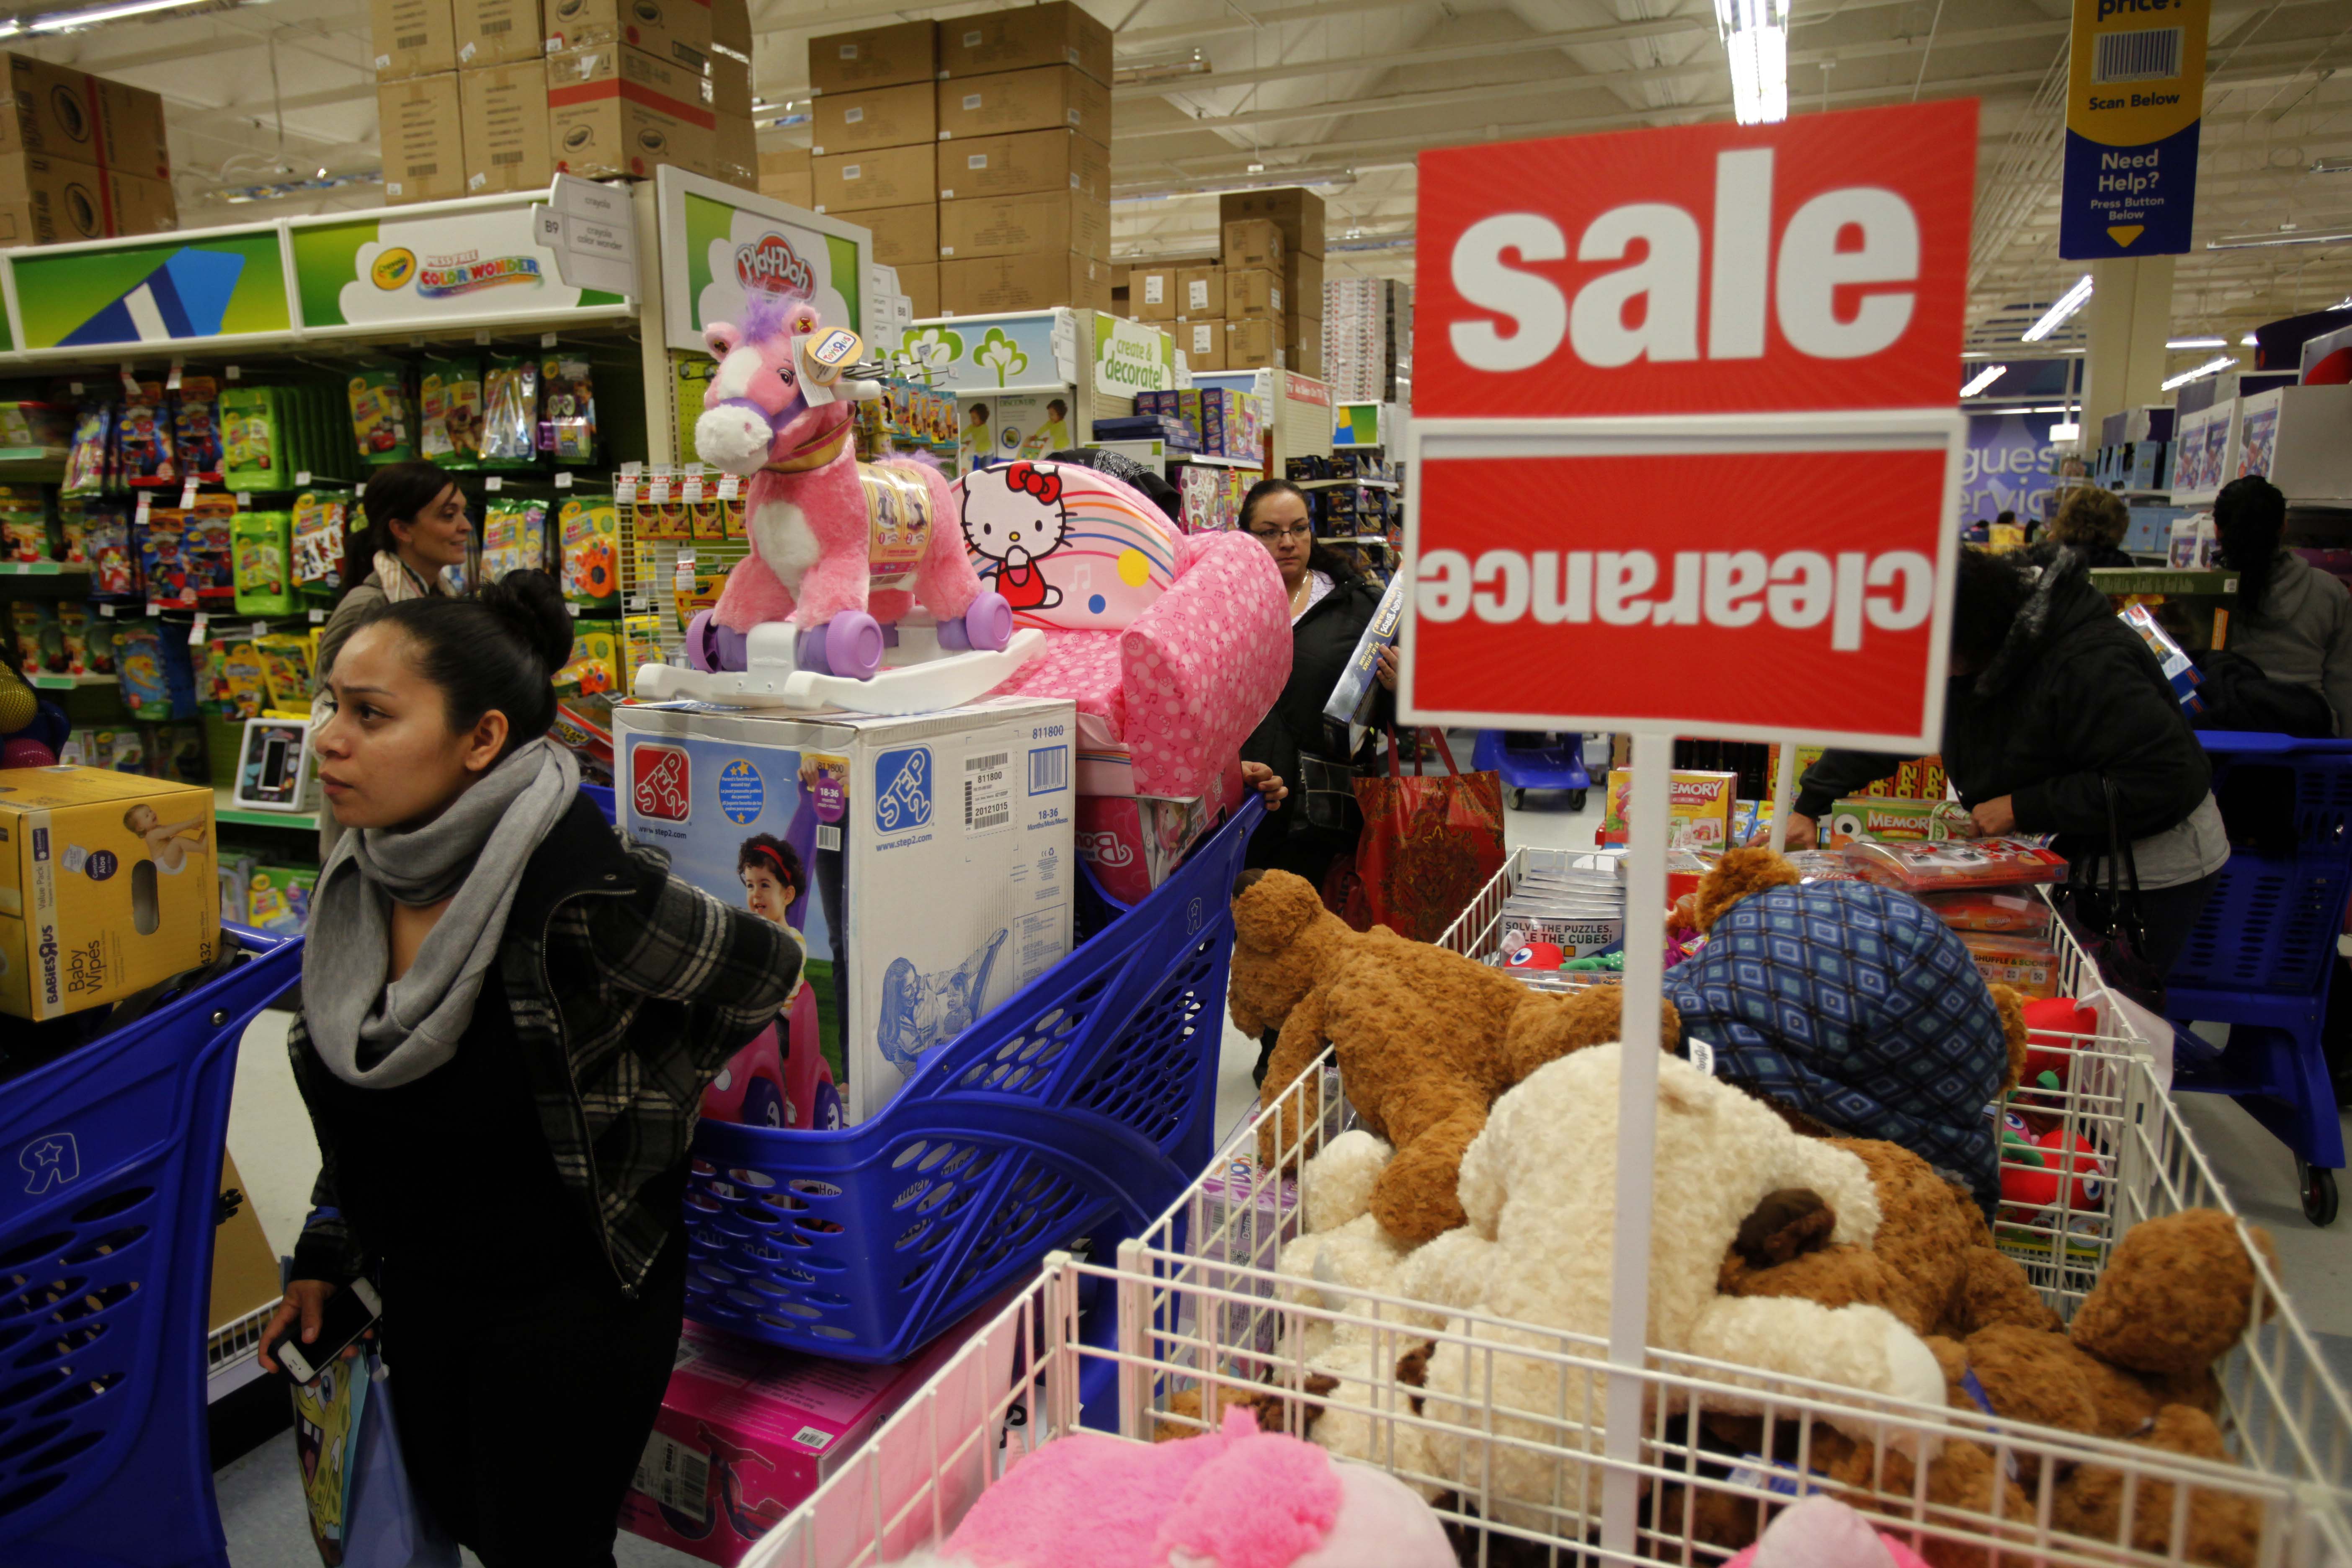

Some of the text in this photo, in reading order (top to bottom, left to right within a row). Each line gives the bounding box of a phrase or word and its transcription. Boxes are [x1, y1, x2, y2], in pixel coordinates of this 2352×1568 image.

[2097, 0, 2181, 22] price
[2089, 92, 2180, 110] Scan Below
[2101, 148, 2159, 170] Need
[2098, 172, 2160, 195] Help?
[585, 197, 611, 209] crayola
[2090, 197, 2164, 209] Press Button
[2109, 210, 2144, 220] Below
[545, 220, 559, 234] B9
[587, 227, 612, 238] crayola
[577, 234, 622, 250] color wonder
[1449, 147, 1921, 372] sale
[420, 258, 539, 285] COLOR WONDER
[738, 246, 810, 293] Play-Doh
[1117, 339, 1153, 362] create &
[1106, 350, 1163, 391] decorate!
[1963, 446, 2054, 486] gues
[1416, 548, 1933, 651] clearance
[1032, 725, 1064, 740] 811800
[636, 751, 681, 812] STEP
[978, 771, 1002, 784] 811800
[820, 787, 839, 798] 18-36
[877, 750, 930, 828] STEP 2
[1670, 781, 1723, 797] EMORY
[975, 802, 1008, 816] 20121015
[1038, 807, 1058, 820] 18-36
[1027, 818, 1068, 831] Months/Mois/Meses
[1868, 810, 1930, 830] MEMOR
[638, 825, 687, 840] www.step2.com
[876, 833, 933, 852] www.step2.com
[37, 887, 46, 910] Value
[1506, 921, 1612, 934] SOLVE THE PUZZLES.
[1541, 934, 1564, 943] THE
[1569, 934, 1612, 944] CUBES!
[200, 941, 211, 965] 432
[1973, 954, 2009, 965] SHUFFLE
[66, 949, 88, 992] Baby
[85, 940, 107, 995] Wipes
